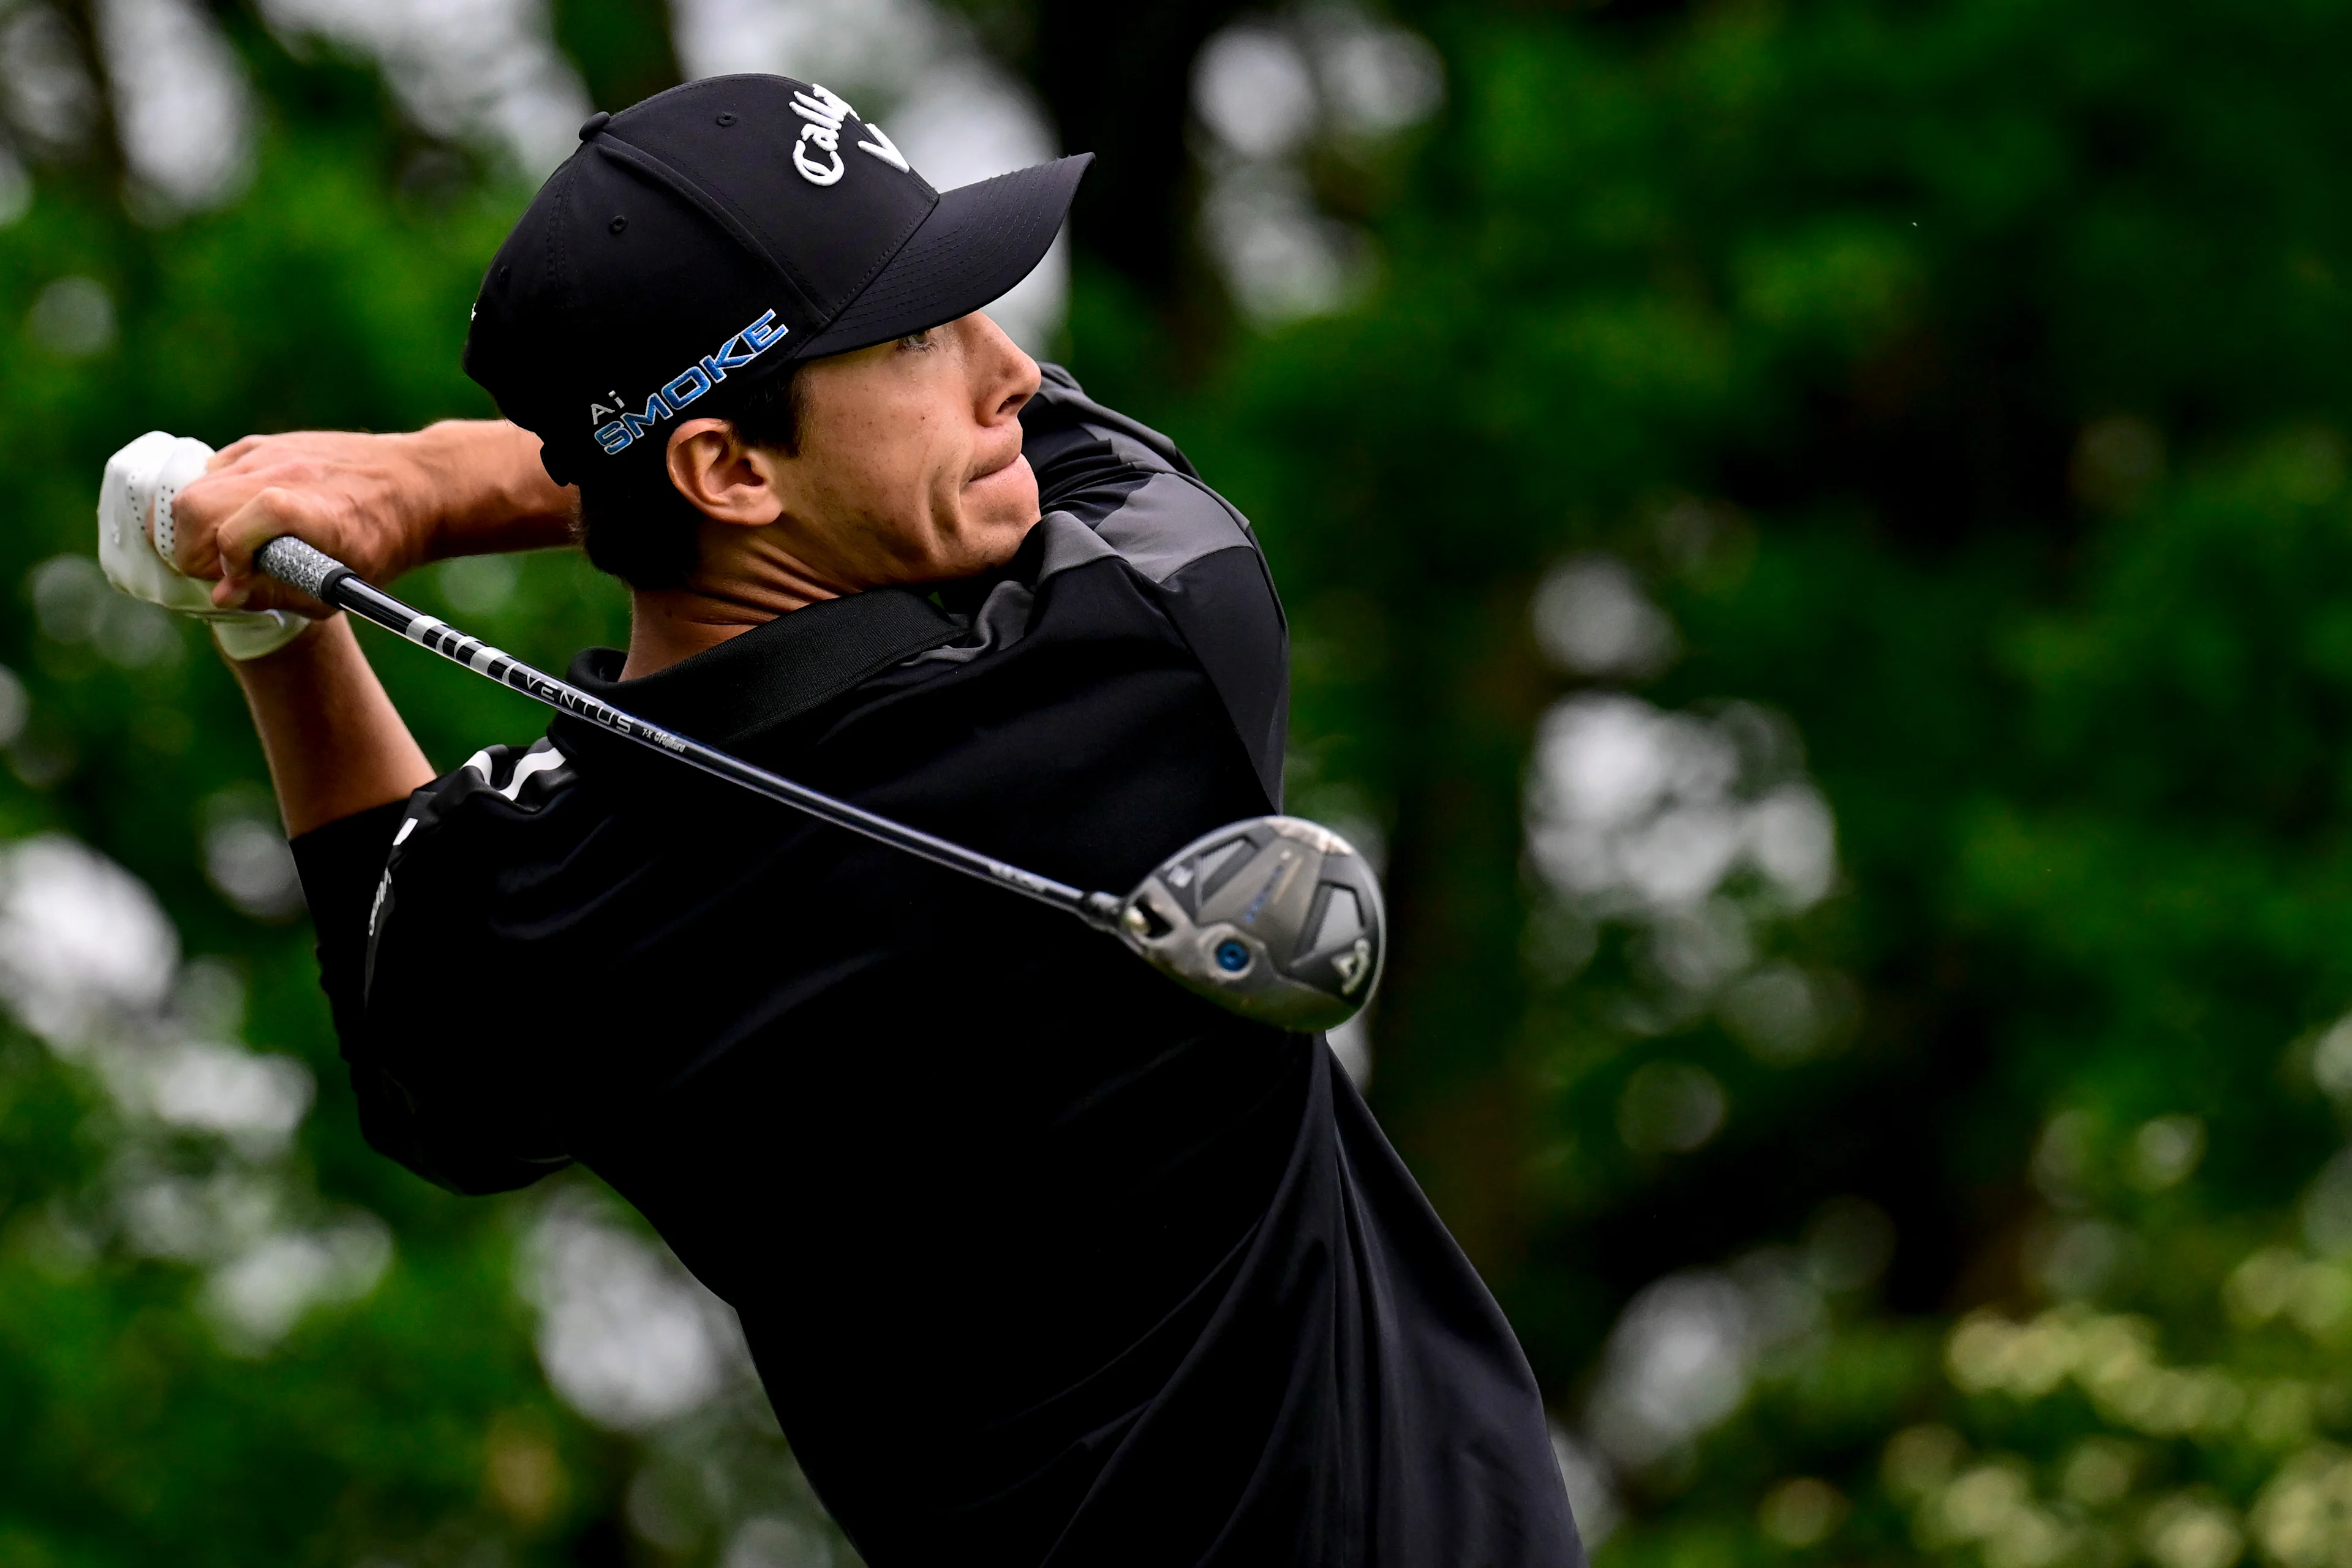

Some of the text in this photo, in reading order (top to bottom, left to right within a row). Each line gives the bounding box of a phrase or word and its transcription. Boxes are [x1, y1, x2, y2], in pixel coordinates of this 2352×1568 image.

[590, 390, 625, 425] Ai
[594, 308, 790, 455] SMOKE
[526, 673, 635, 734] VENTUS
